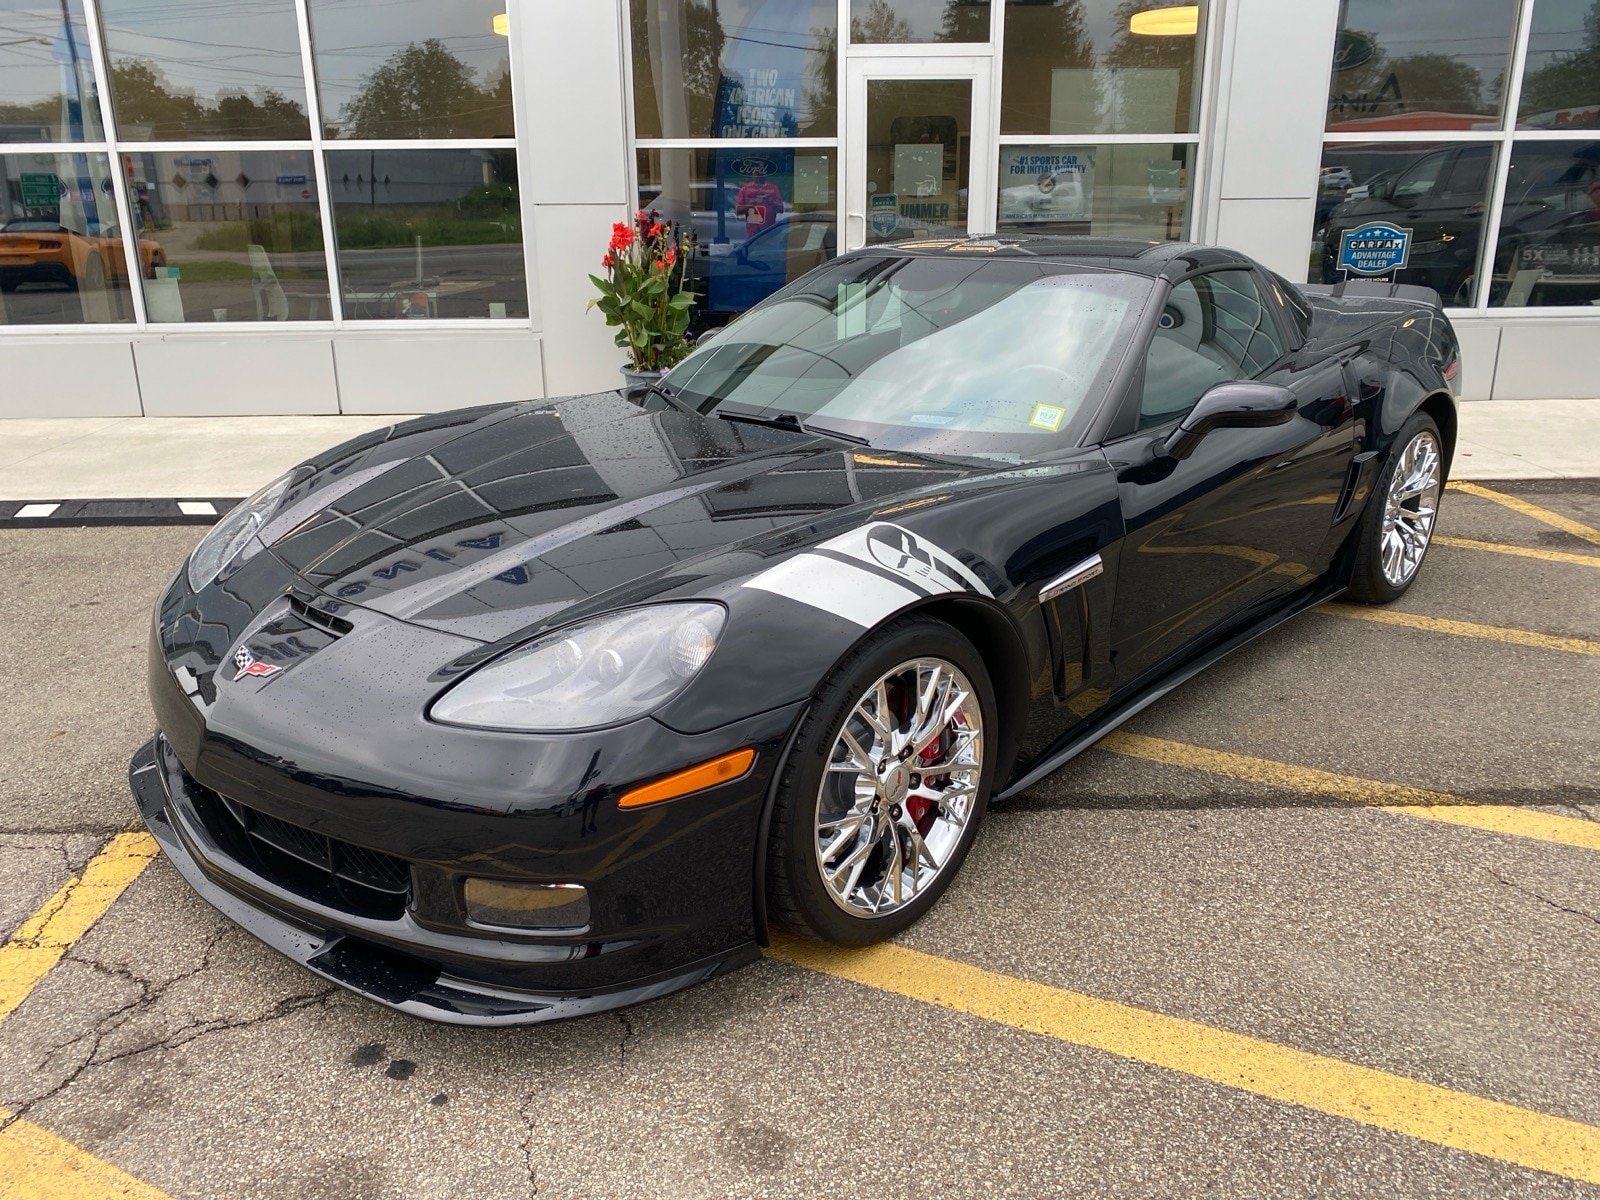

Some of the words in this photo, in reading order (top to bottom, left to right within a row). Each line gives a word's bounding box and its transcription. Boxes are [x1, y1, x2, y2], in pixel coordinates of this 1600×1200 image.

[748, 68, 778, 87] TWO
[728, 87, 795, 107] AMERICAN
[736, 105, 782, 125] ICONS.
[721, 124, 749, 138] ONE
[1018, 155, 1028, 165] #1
[1030, 155, 1060, 165] SPORTS
[1061, 155, 1078, 165] CAR
[740, 160, 769, 174] Ford
[1010, 165, 1026, 174] FOR
[1027, 165, 1053, 174] INITIAL
[1054, 165, 1086, 175] QUALITY
[1350, 241, 1401, 249] CARFAX
[1351, 251, 1397, 260] ADVANTAGE
[1523, 249, 1544, 260] 5X
[1357, 260, 1388, 268] DEALER
